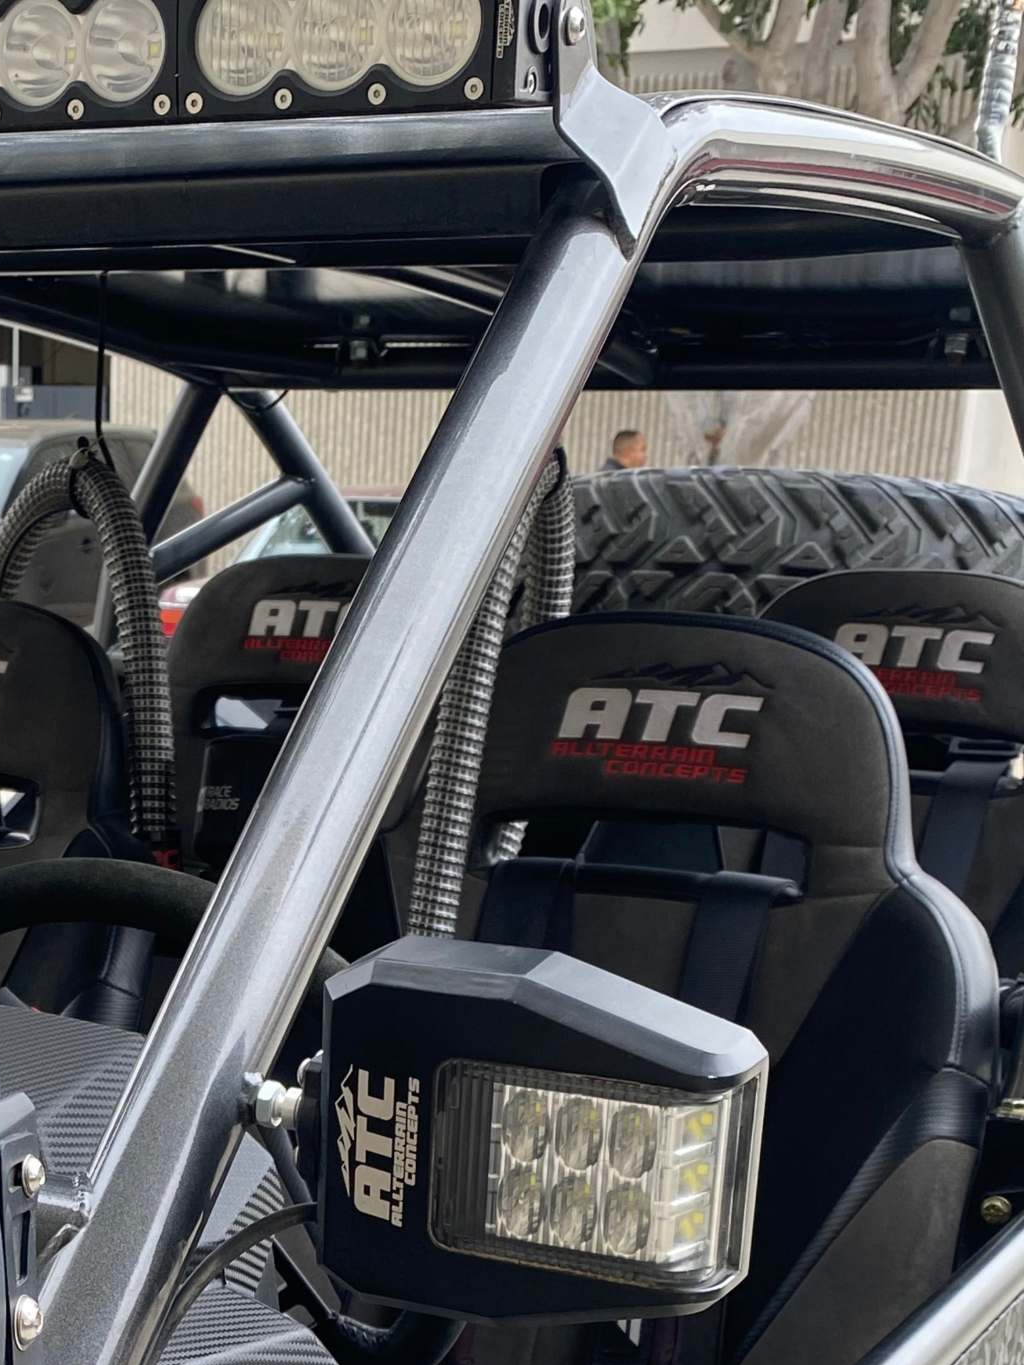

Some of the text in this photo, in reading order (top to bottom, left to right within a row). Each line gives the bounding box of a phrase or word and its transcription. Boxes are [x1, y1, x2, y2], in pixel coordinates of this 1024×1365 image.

[503, 0, 511, 45] TERRAIN
[834, 622, 995, 674] ATC
[557, 687, 765, 749] ATC
[549, 740, 716, 765] ALLTERRAIN
[604, 759, 749, 785] CONCEPTS
[354, 1069, 395, 1220] ATC
[404, 1076, 420, 1187] CONCEPTS
[391, 1101, 407, 1228] ALLTERRAIN
